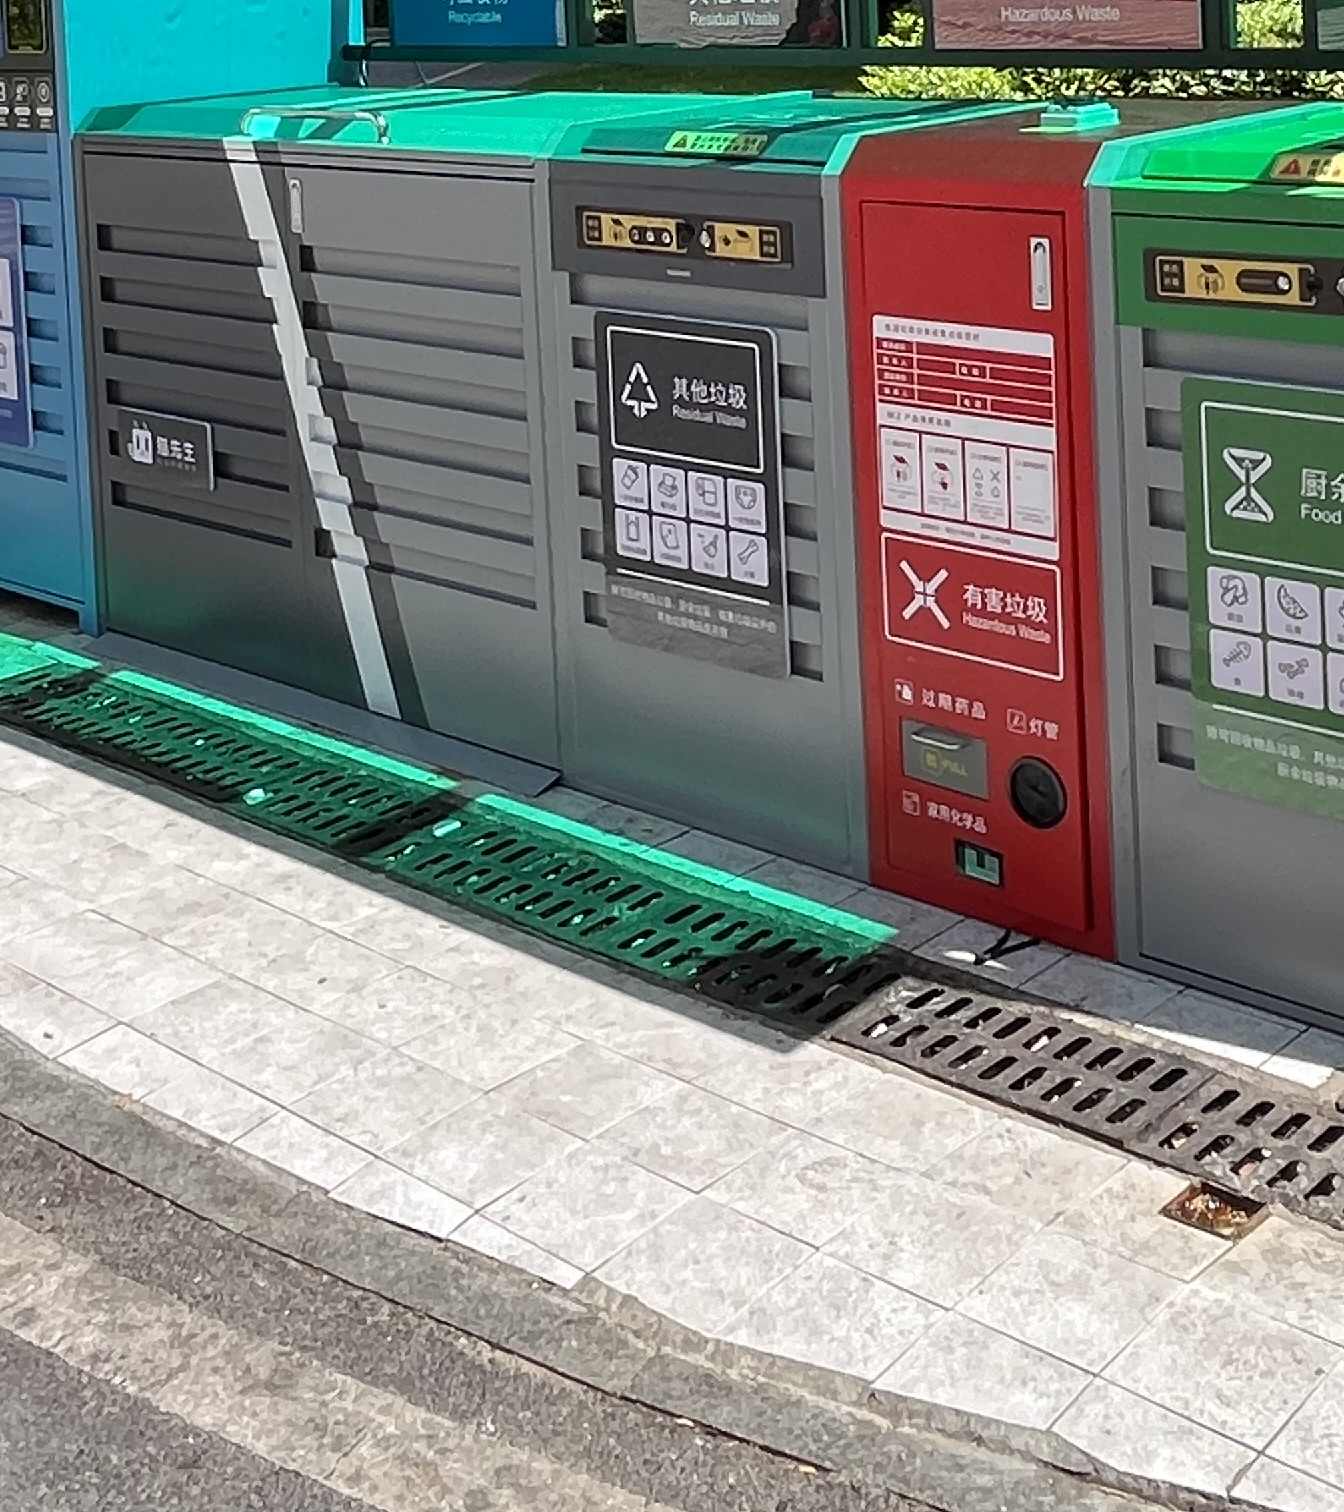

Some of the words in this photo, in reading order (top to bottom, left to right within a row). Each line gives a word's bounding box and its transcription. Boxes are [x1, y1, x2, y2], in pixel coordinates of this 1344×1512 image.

[1000, 5, 1073, 24] Hazardous
[1076, 4, 1120, 23] Waste
[672, 376, 747, 409] 其他垃圾
[1301, 503, 1341, 525] Food
[962, 583, 1049, 623] 有害垃圾
[922, 688, 986, 719] 过期药品
[1029, 717, 1059, 740] 灯管
